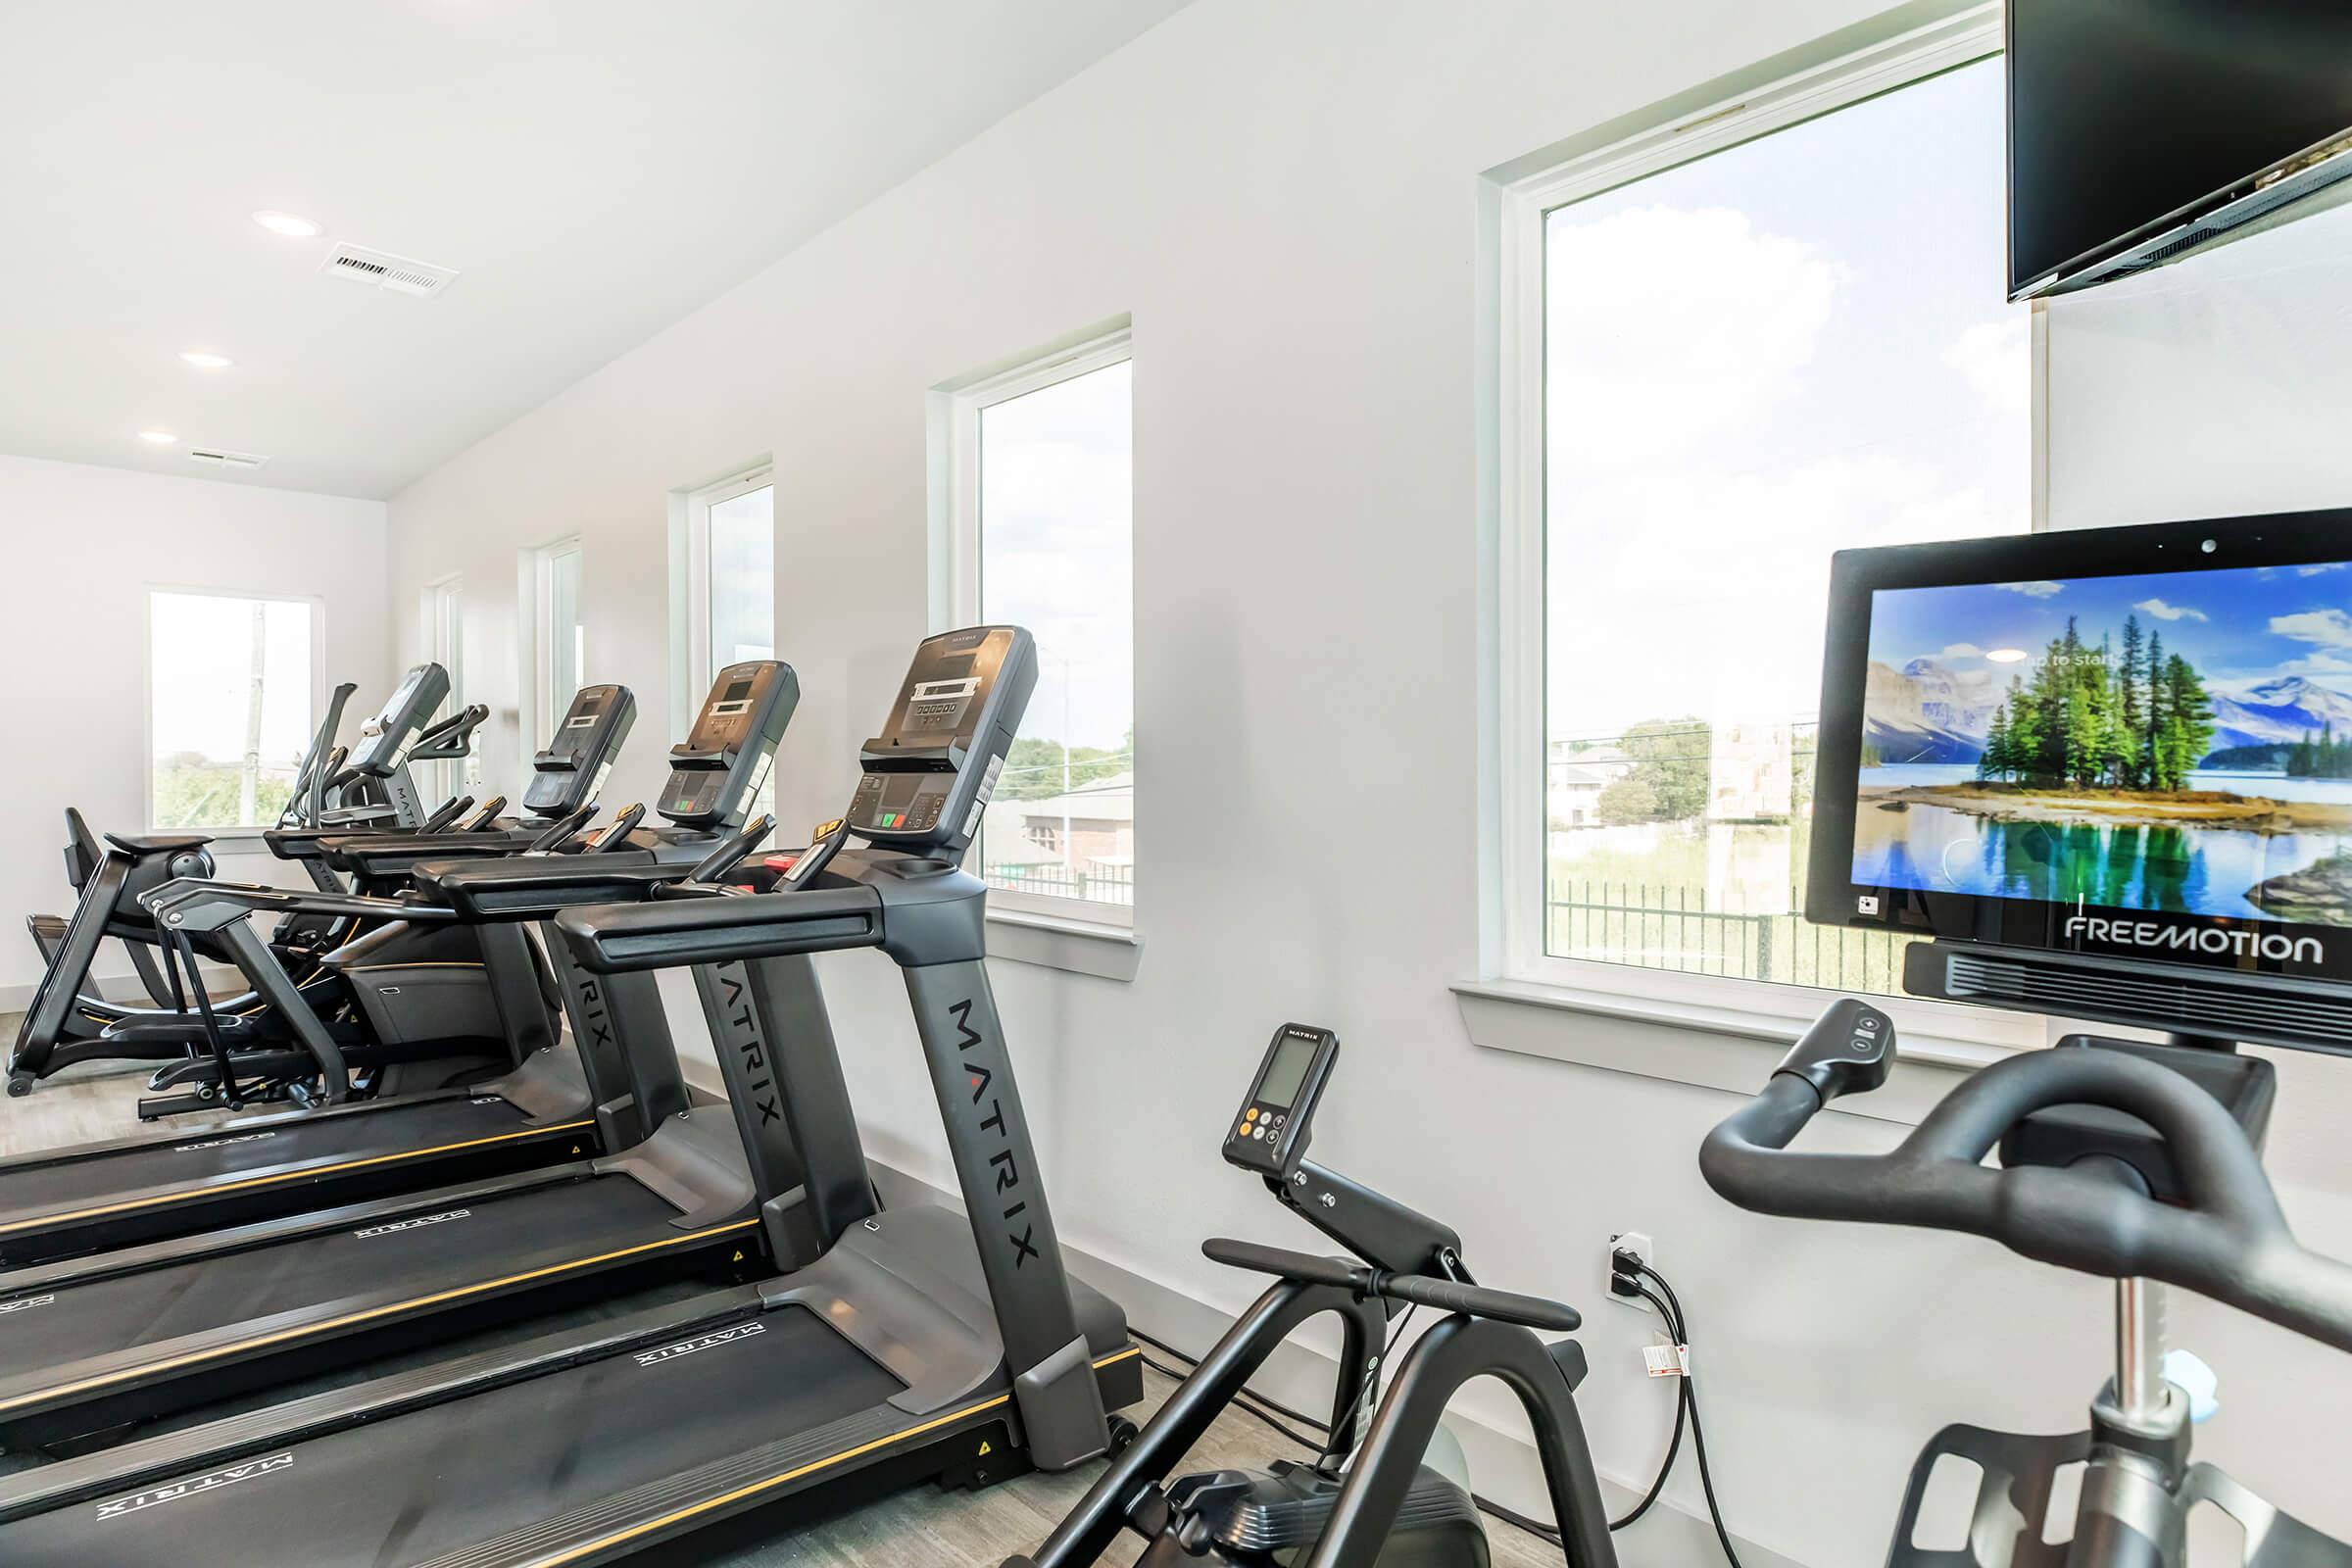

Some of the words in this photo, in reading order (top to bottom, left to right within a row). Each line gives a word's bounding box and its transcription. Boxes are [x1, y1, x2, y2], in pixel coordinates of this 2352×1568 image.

[2053, 654, 2070, 666] to
[2065, 915, 2324, 964] FREEMOTION
[1289, 1029, 1318, 1041] MATRIX
[948, 998, 1040, 1271] MATRIX
[354, 1208, 471, 1240] MATRIX
[634, 1323, 765, 1365] MATRIX
[97, 1453, 294, 1518] MATRIX
